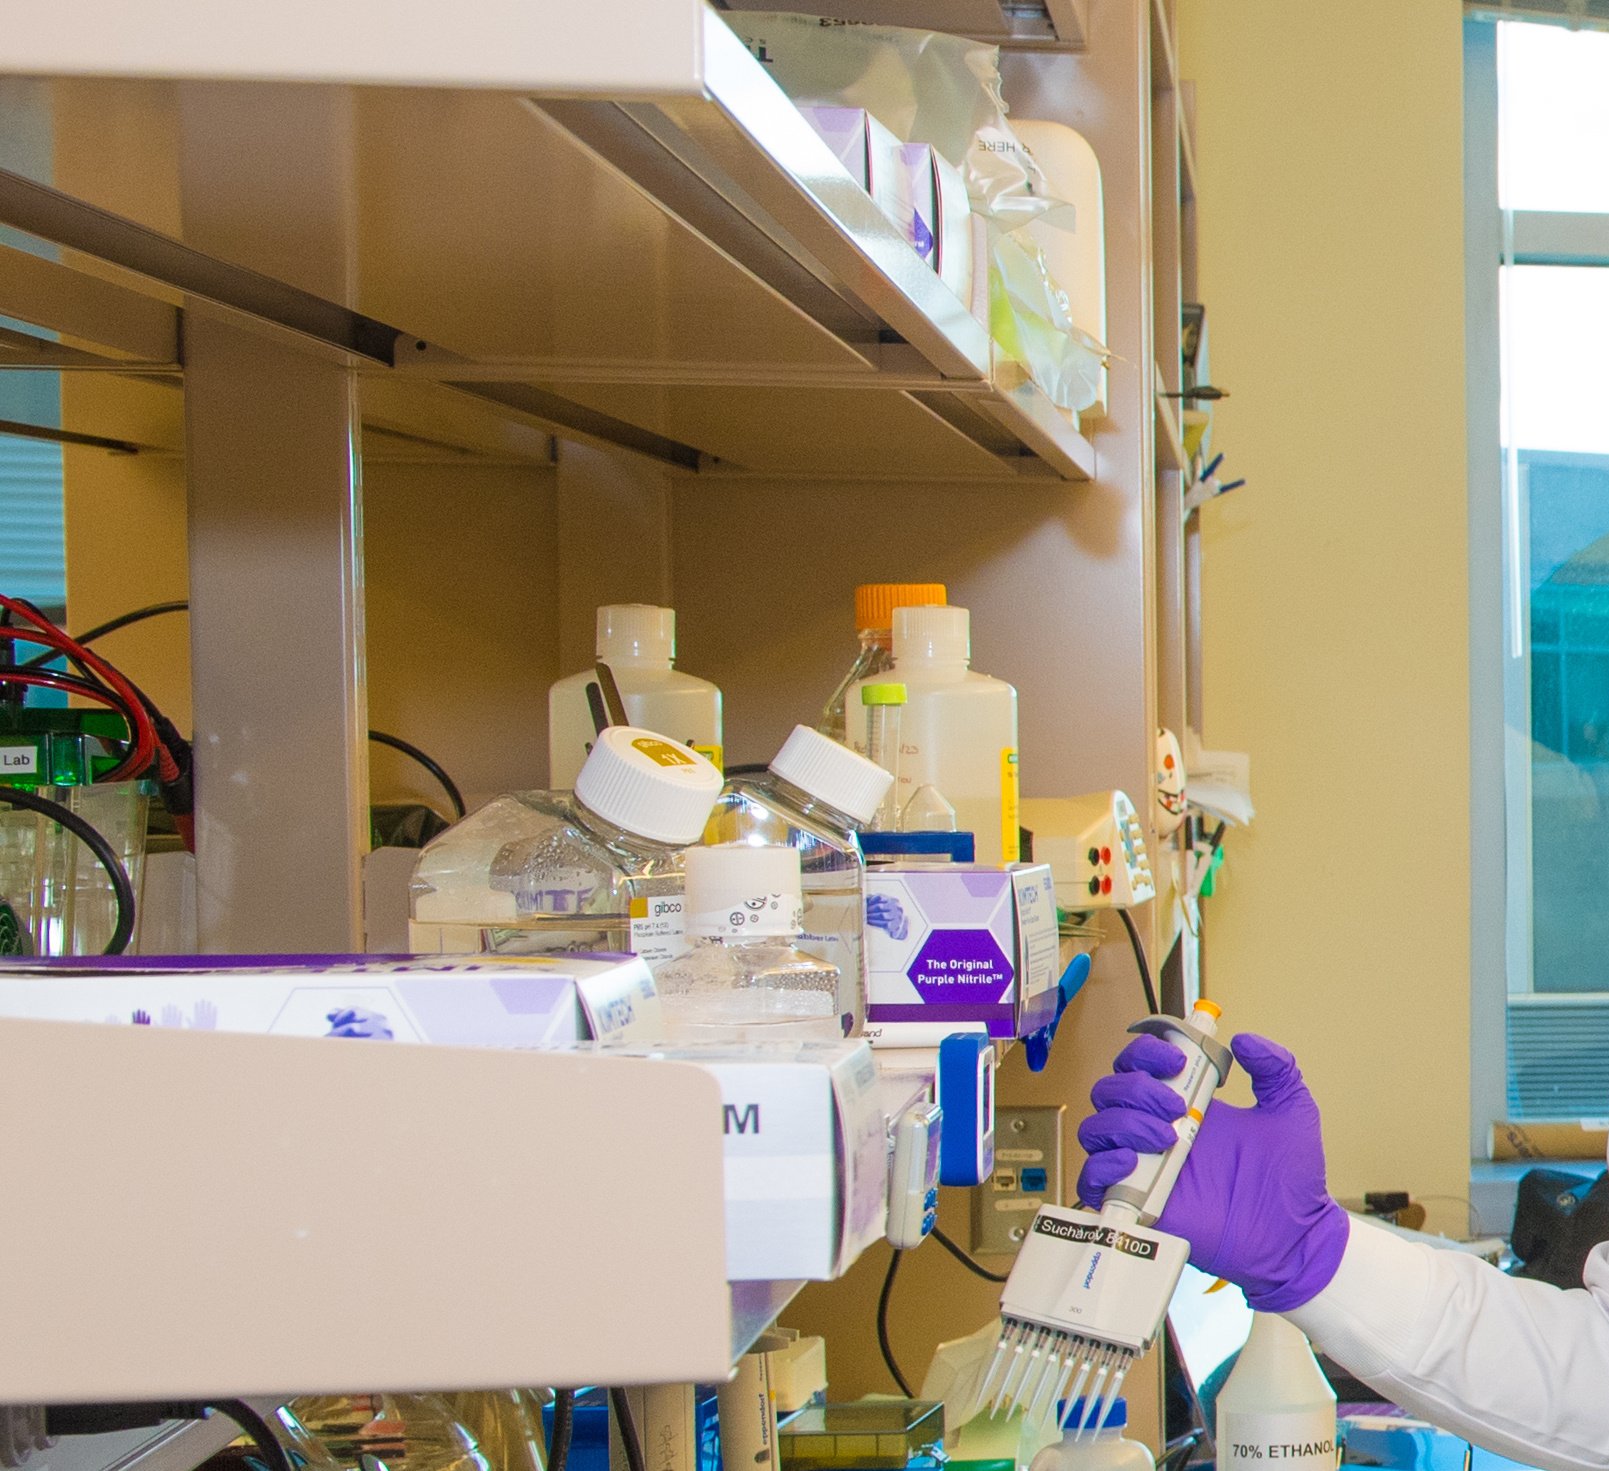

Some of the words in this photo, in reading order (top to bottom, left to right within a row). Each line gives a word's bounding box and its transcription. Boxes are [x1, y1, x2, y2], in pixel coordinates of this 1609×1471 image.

[978, 140, 1016, 153] HERE
[3, 754, 30, 766] Lab
[655, 901, 682, 917] gibco
[926, 959, 947, 970] The
[949, 959, 994, 973] Original
[917, 974, 955, 986] Purple
[1041, 1219, 1104, 1242] Sucharov
[1082, 1251, 1102, 1290] eppendorf
[758, 1392, 769, 1446] eppendorf
[1232, 1444, 1263, 1459] 70%
